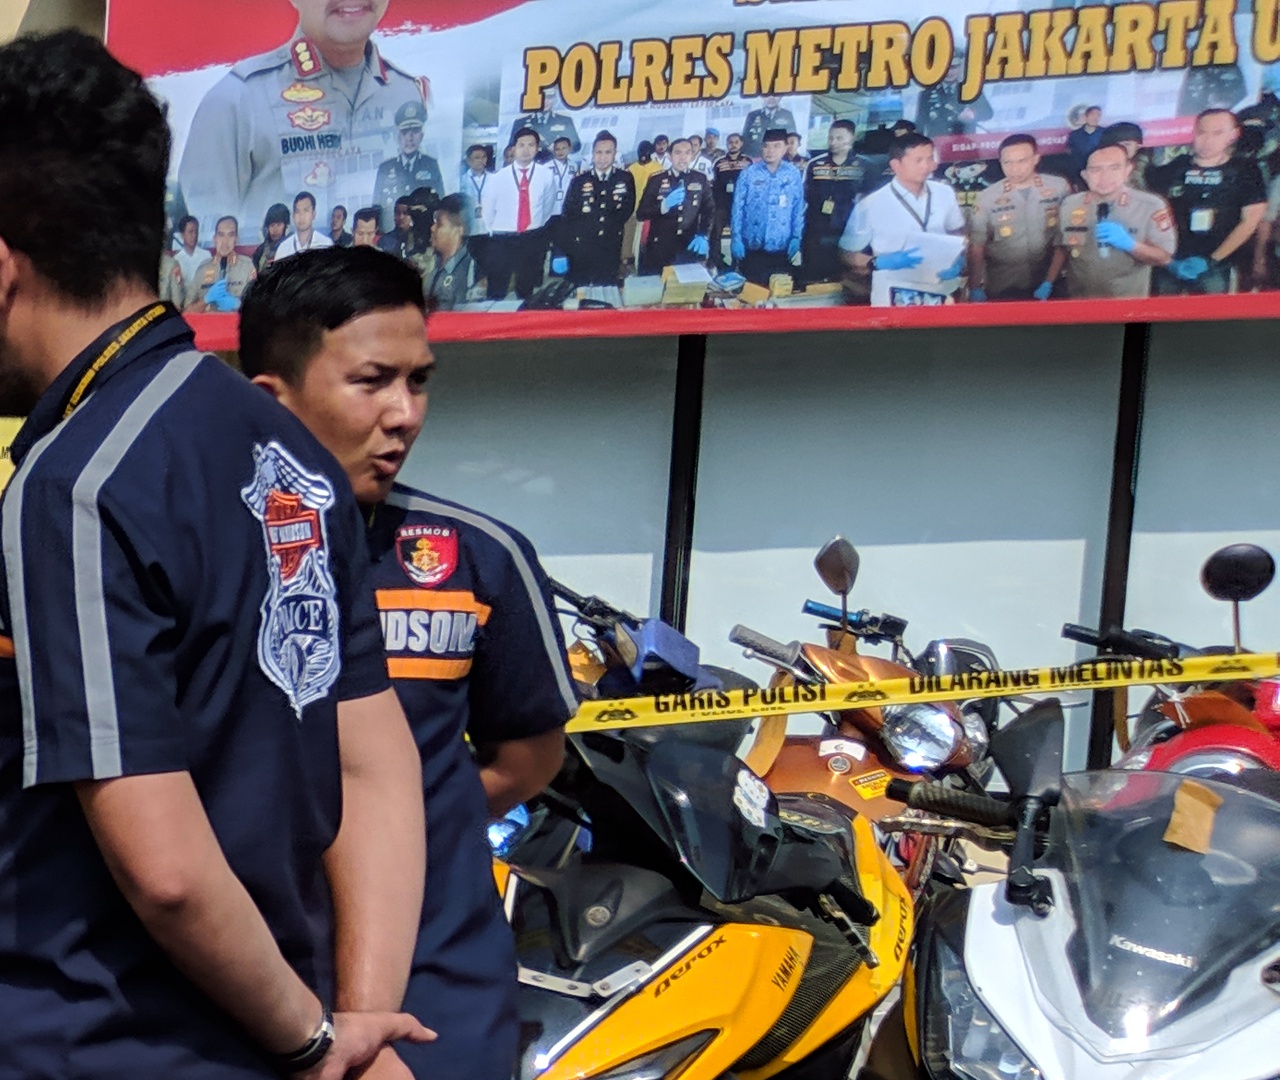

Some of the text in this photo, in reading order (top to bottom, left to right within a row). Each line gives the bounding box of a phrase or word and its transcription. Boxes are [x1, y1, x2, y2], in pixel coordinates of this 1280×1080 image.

[521, 33, 734, 111] POLRES
[742, 18, 954, 98] METRO
[957, 1, 1239, 101] JAKARTA
[280, 133, 316, 154] BUDHI
[909, 669, 1040, 695] DILARANG
[1049, 657, 1184, 685] MELINTAS
[654, 682, 828, 713] GARIS POLISI
[771, 945, 801, 992] YAMAHA
[1108, 934, 1195, 969] Kawasaki
